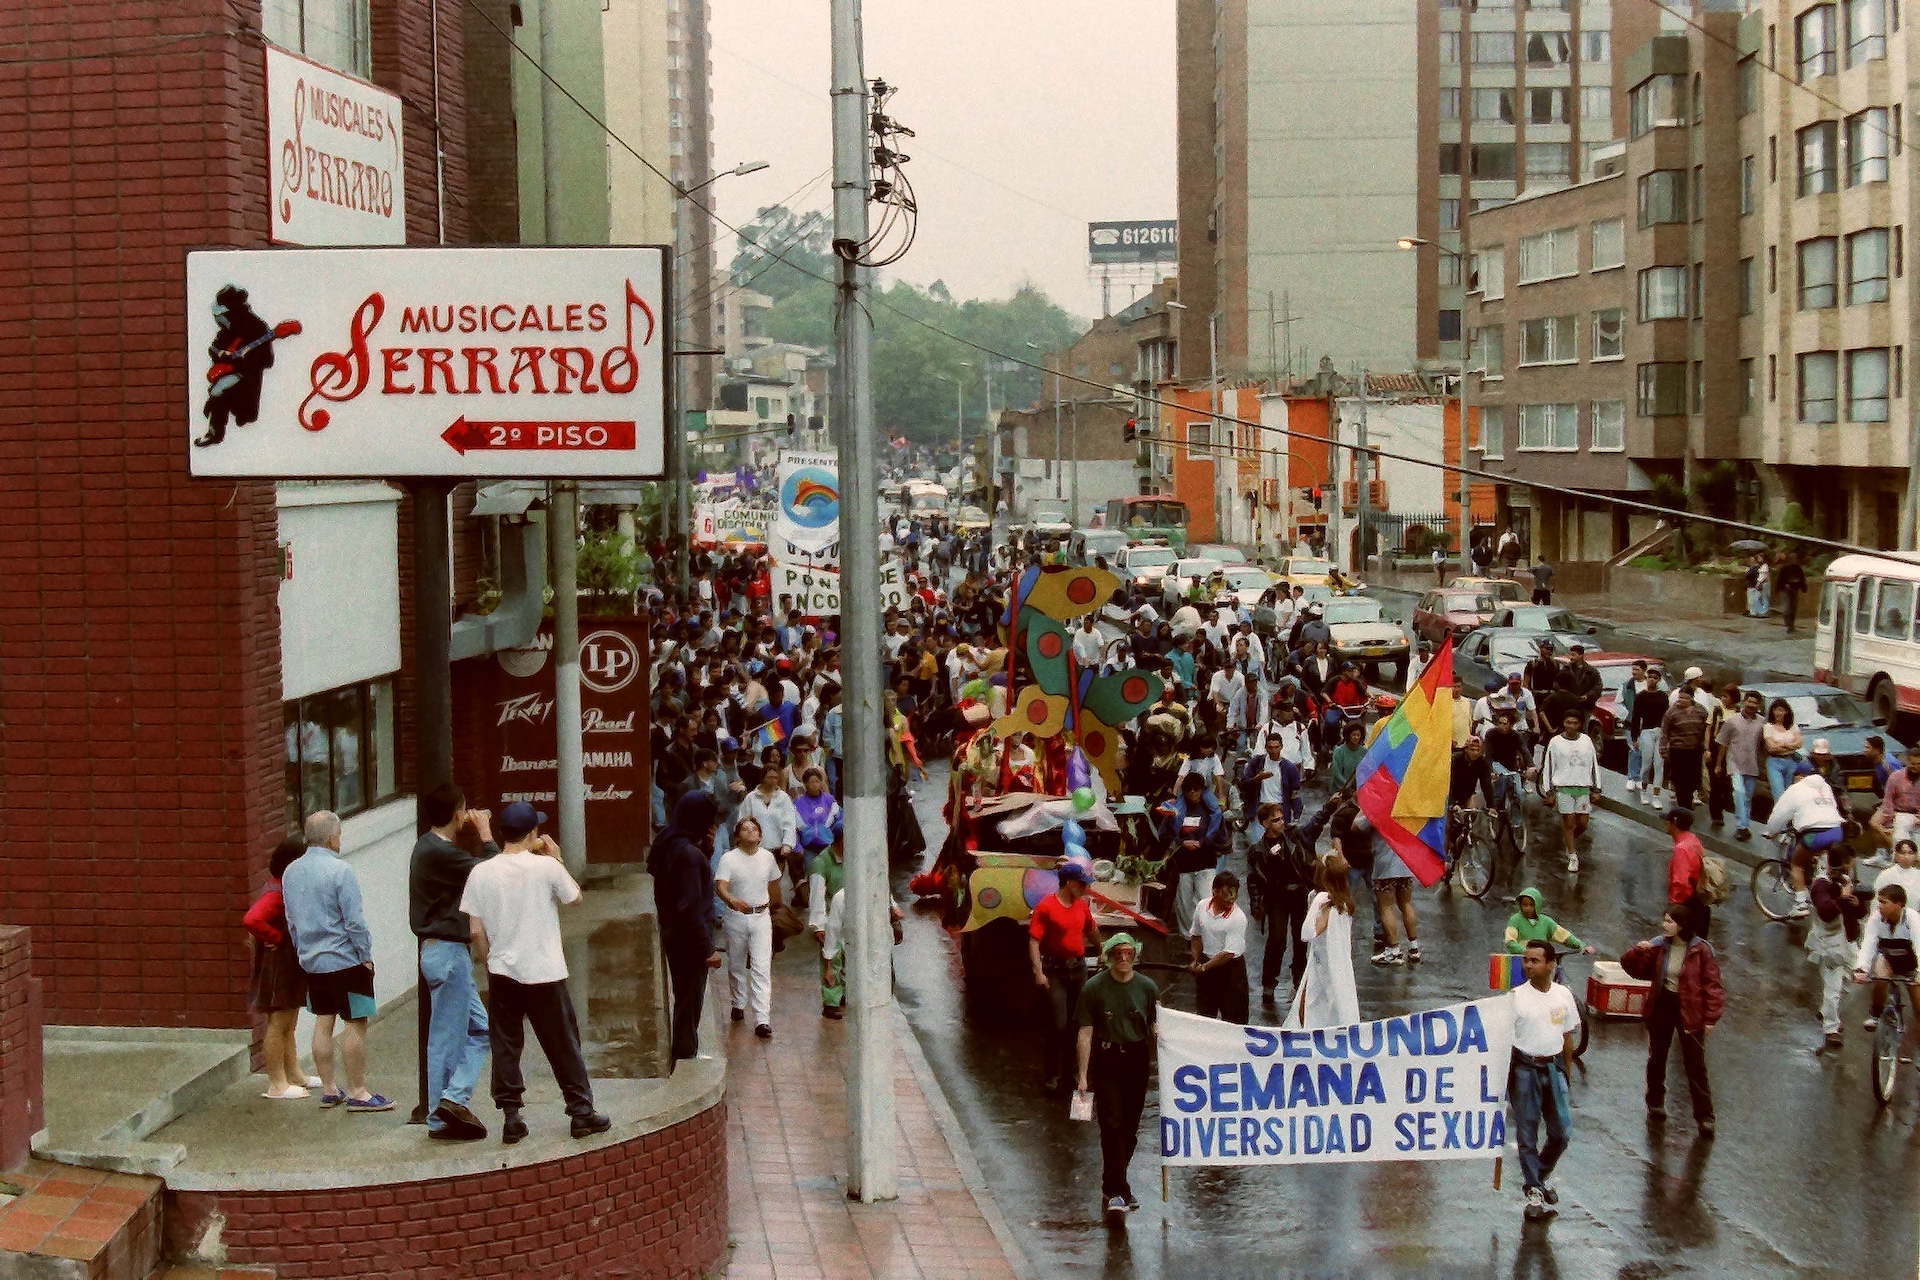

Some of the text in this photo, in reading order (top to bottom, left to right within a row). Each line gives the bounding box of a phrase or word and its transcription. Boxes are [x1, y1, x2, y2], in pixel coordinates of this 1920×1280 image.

[310, 87, 385, 142] MUSICALES
[280, 78, 398, 224] SERRANO
[1122, 227, 1178, 245] 612611
[400, 303, 608, 333] MUSICALES
[299, 288, 642, 431] SERRANO
[537, 425, 608, 446] PISO
[587, 644, 631, 678] LP
[581, 708, 635, 733] Pearl
[581, 751, 633, 768] AMAHA
[1243, 1005, 1489, 1059] SEGUNDA
[1172, 1062, 1507, 1113] SEMANA DE L
[1160, 1113, 1373, 1158] DIVERSIDAD
